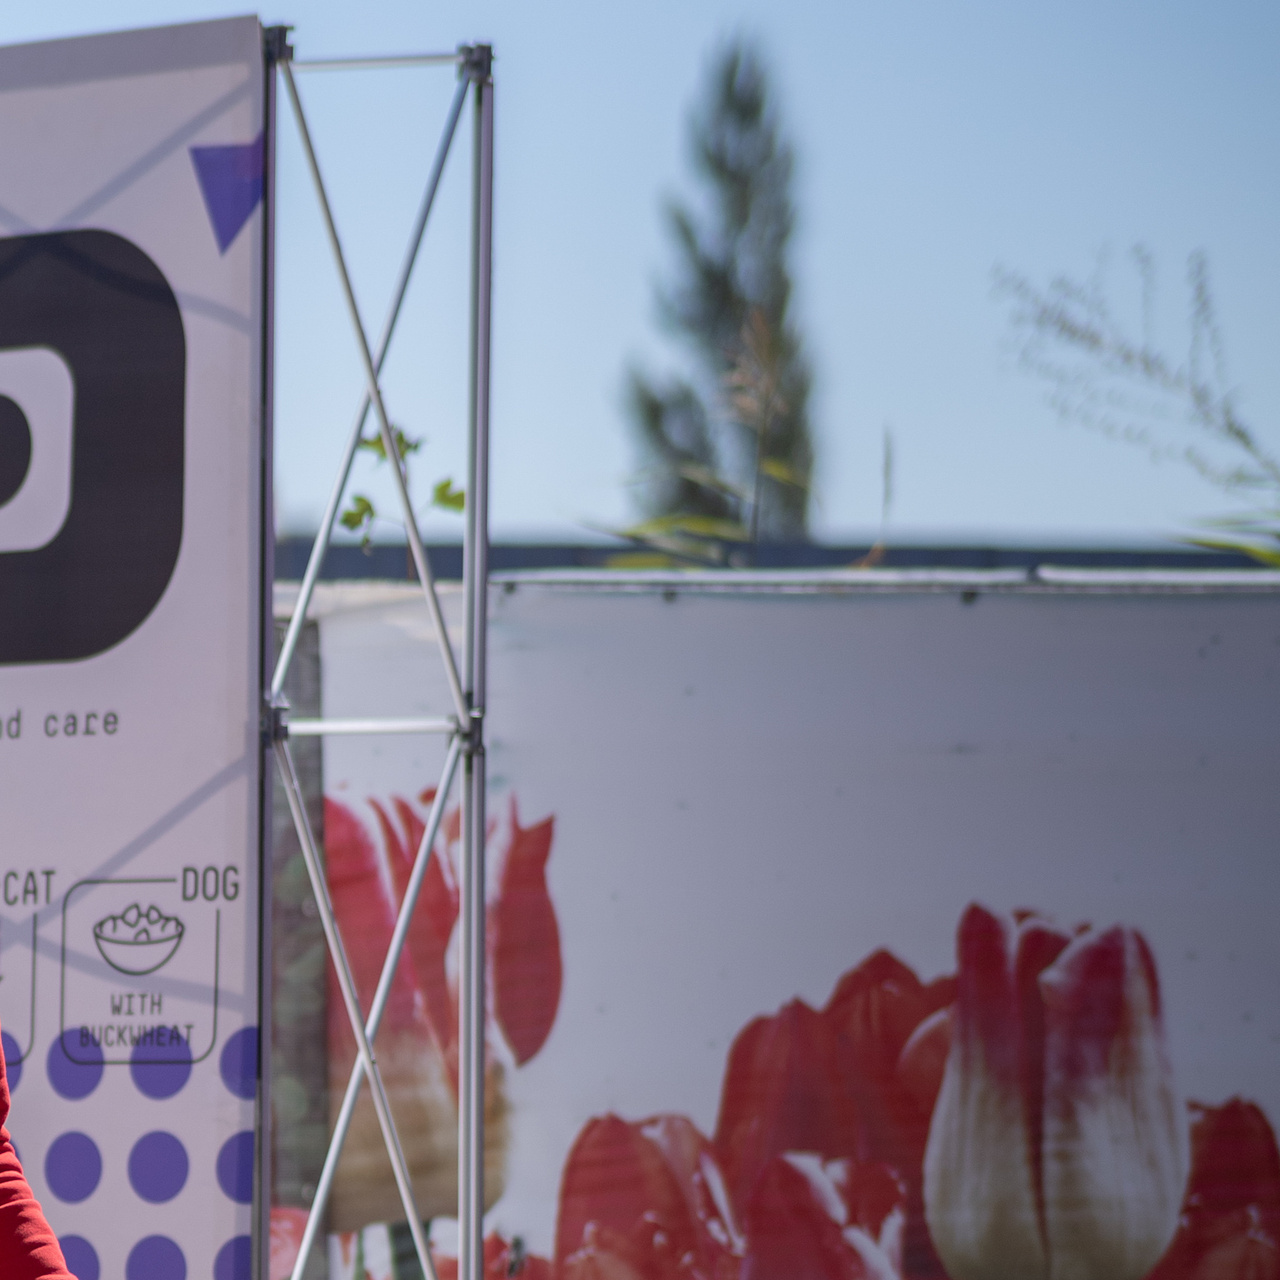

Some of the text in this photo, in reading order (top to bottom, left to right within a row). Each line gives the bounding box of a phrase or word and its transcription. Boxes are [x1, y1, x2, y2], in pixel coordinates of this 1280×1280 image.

[43, 710, 120, 738] care
[3, 870, 57, 906] CAT
[181, 866, 240, 902] DOG
[110, 993, 163, 1015] WITH
[79, 1024, 195, 1048] BUCKWHEAT
